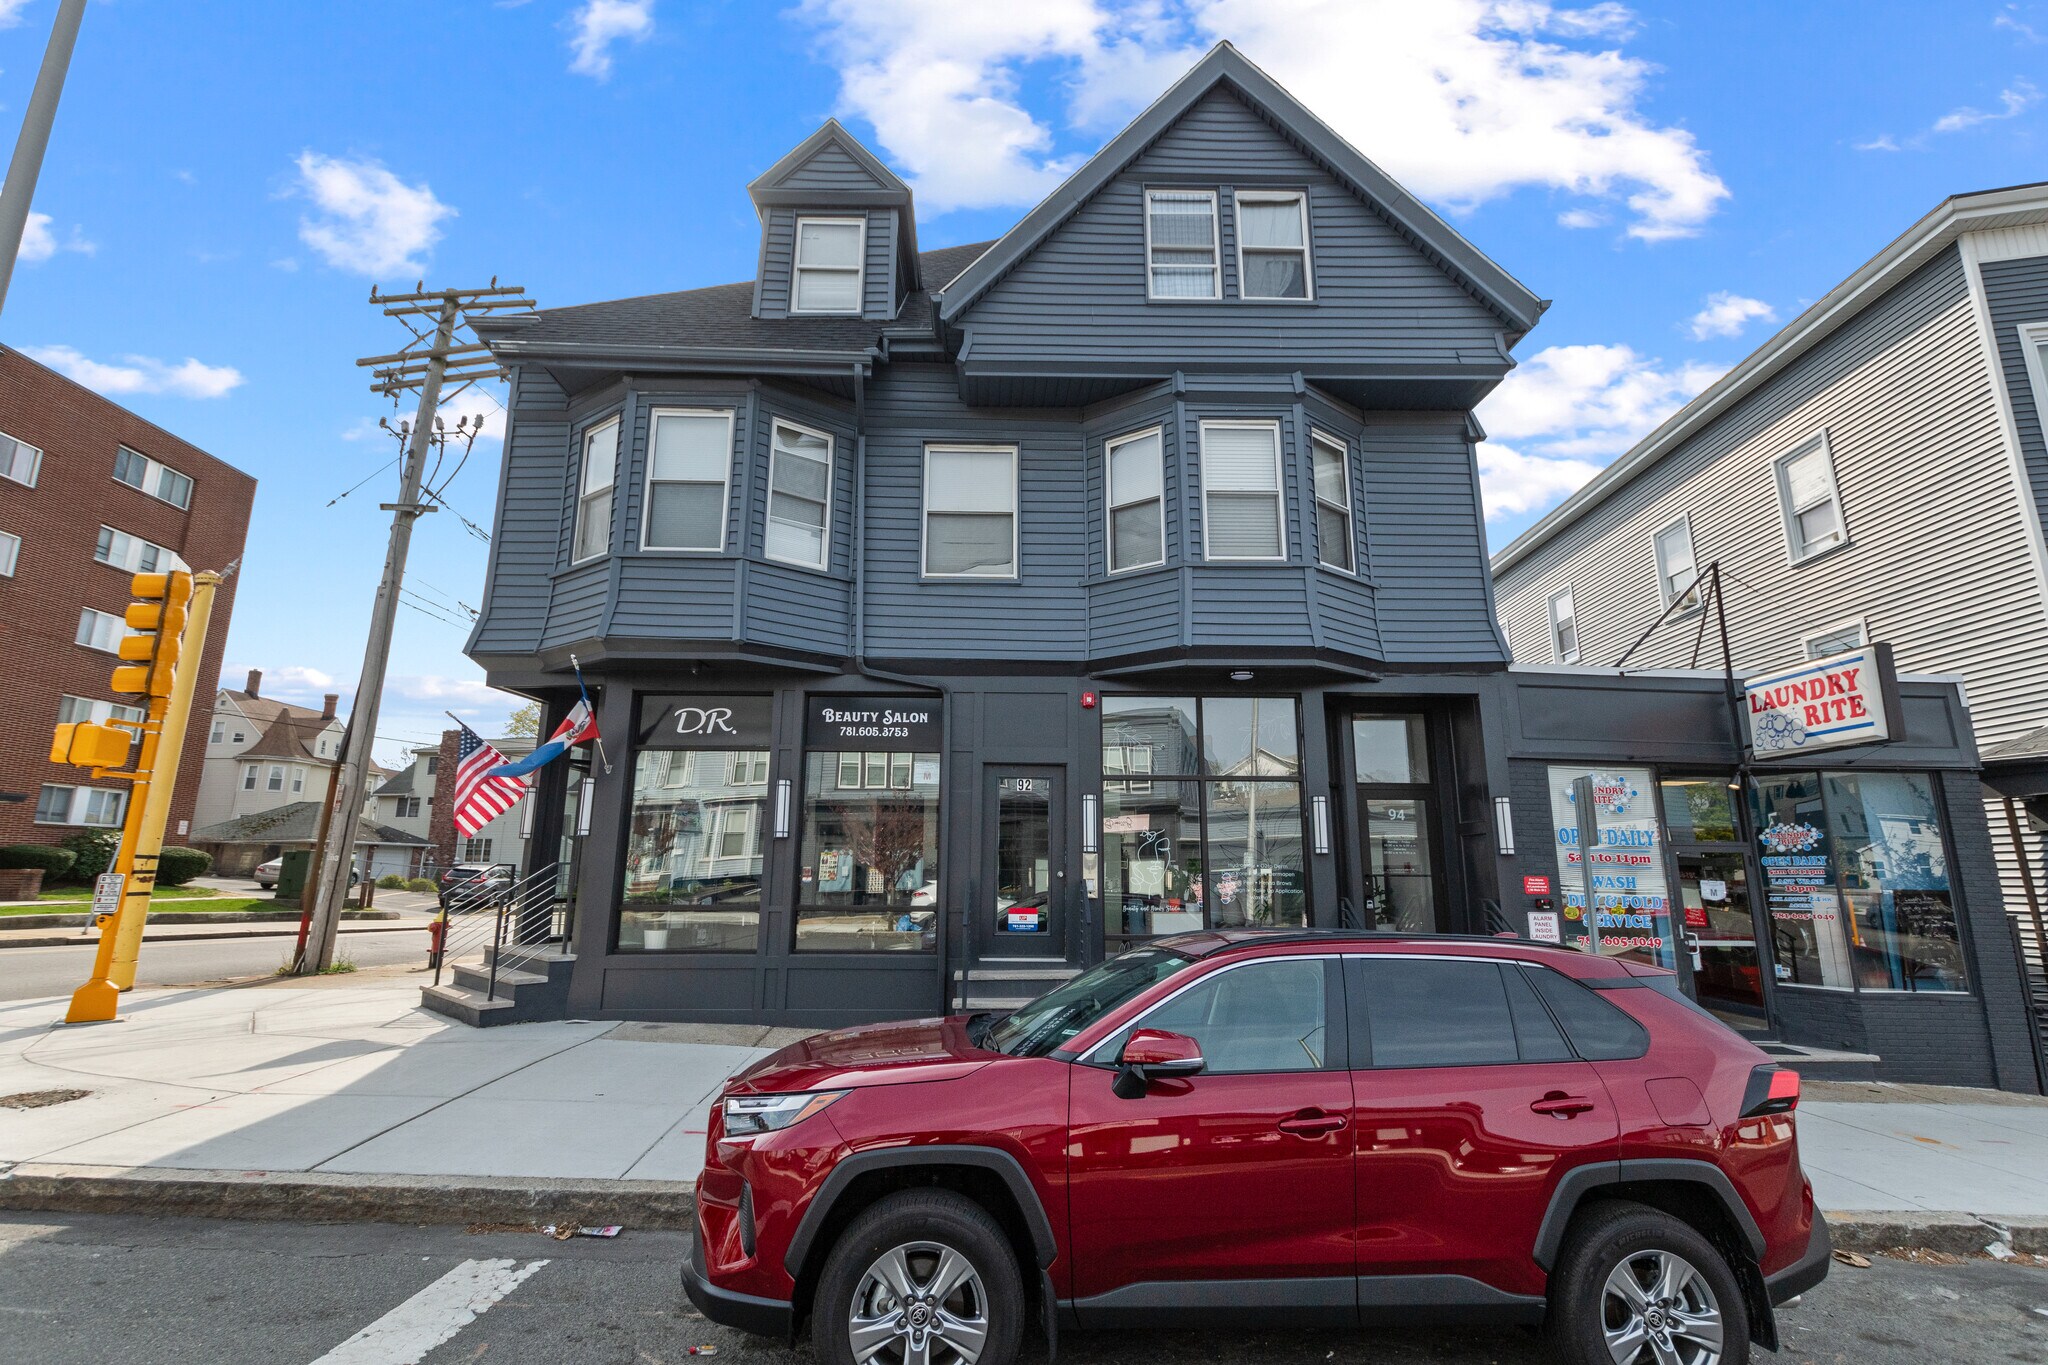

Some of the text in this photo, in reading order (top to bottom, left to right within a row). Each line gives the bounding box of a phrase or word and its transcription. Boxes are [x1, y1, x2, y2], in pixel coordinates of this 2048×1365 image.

[1749, 668, 1860, 714] LAUNDRY
[1803, 694, 1867, 727] RITE
[674, 707, 737, 735] D.R.
[839, 726, 909, 737] 781.605.3753
[1018, 779, 1031, 791] 92
[1388, 808, 1406, 821] 94
[1606, 829, 1655, 847] DAILY
[1598, 854, 1612, 862] to
[1616, 854, 1651, 864] 11pm
[1761, 855, 1828, 866] OPEN DAILY
[1593, 875, 1637, 888] WASH
[1785, 885, 1816, 893] 10pm
[1605, 895, 1618, 908] &
[1621, 895, 1663, 909] FOLD
